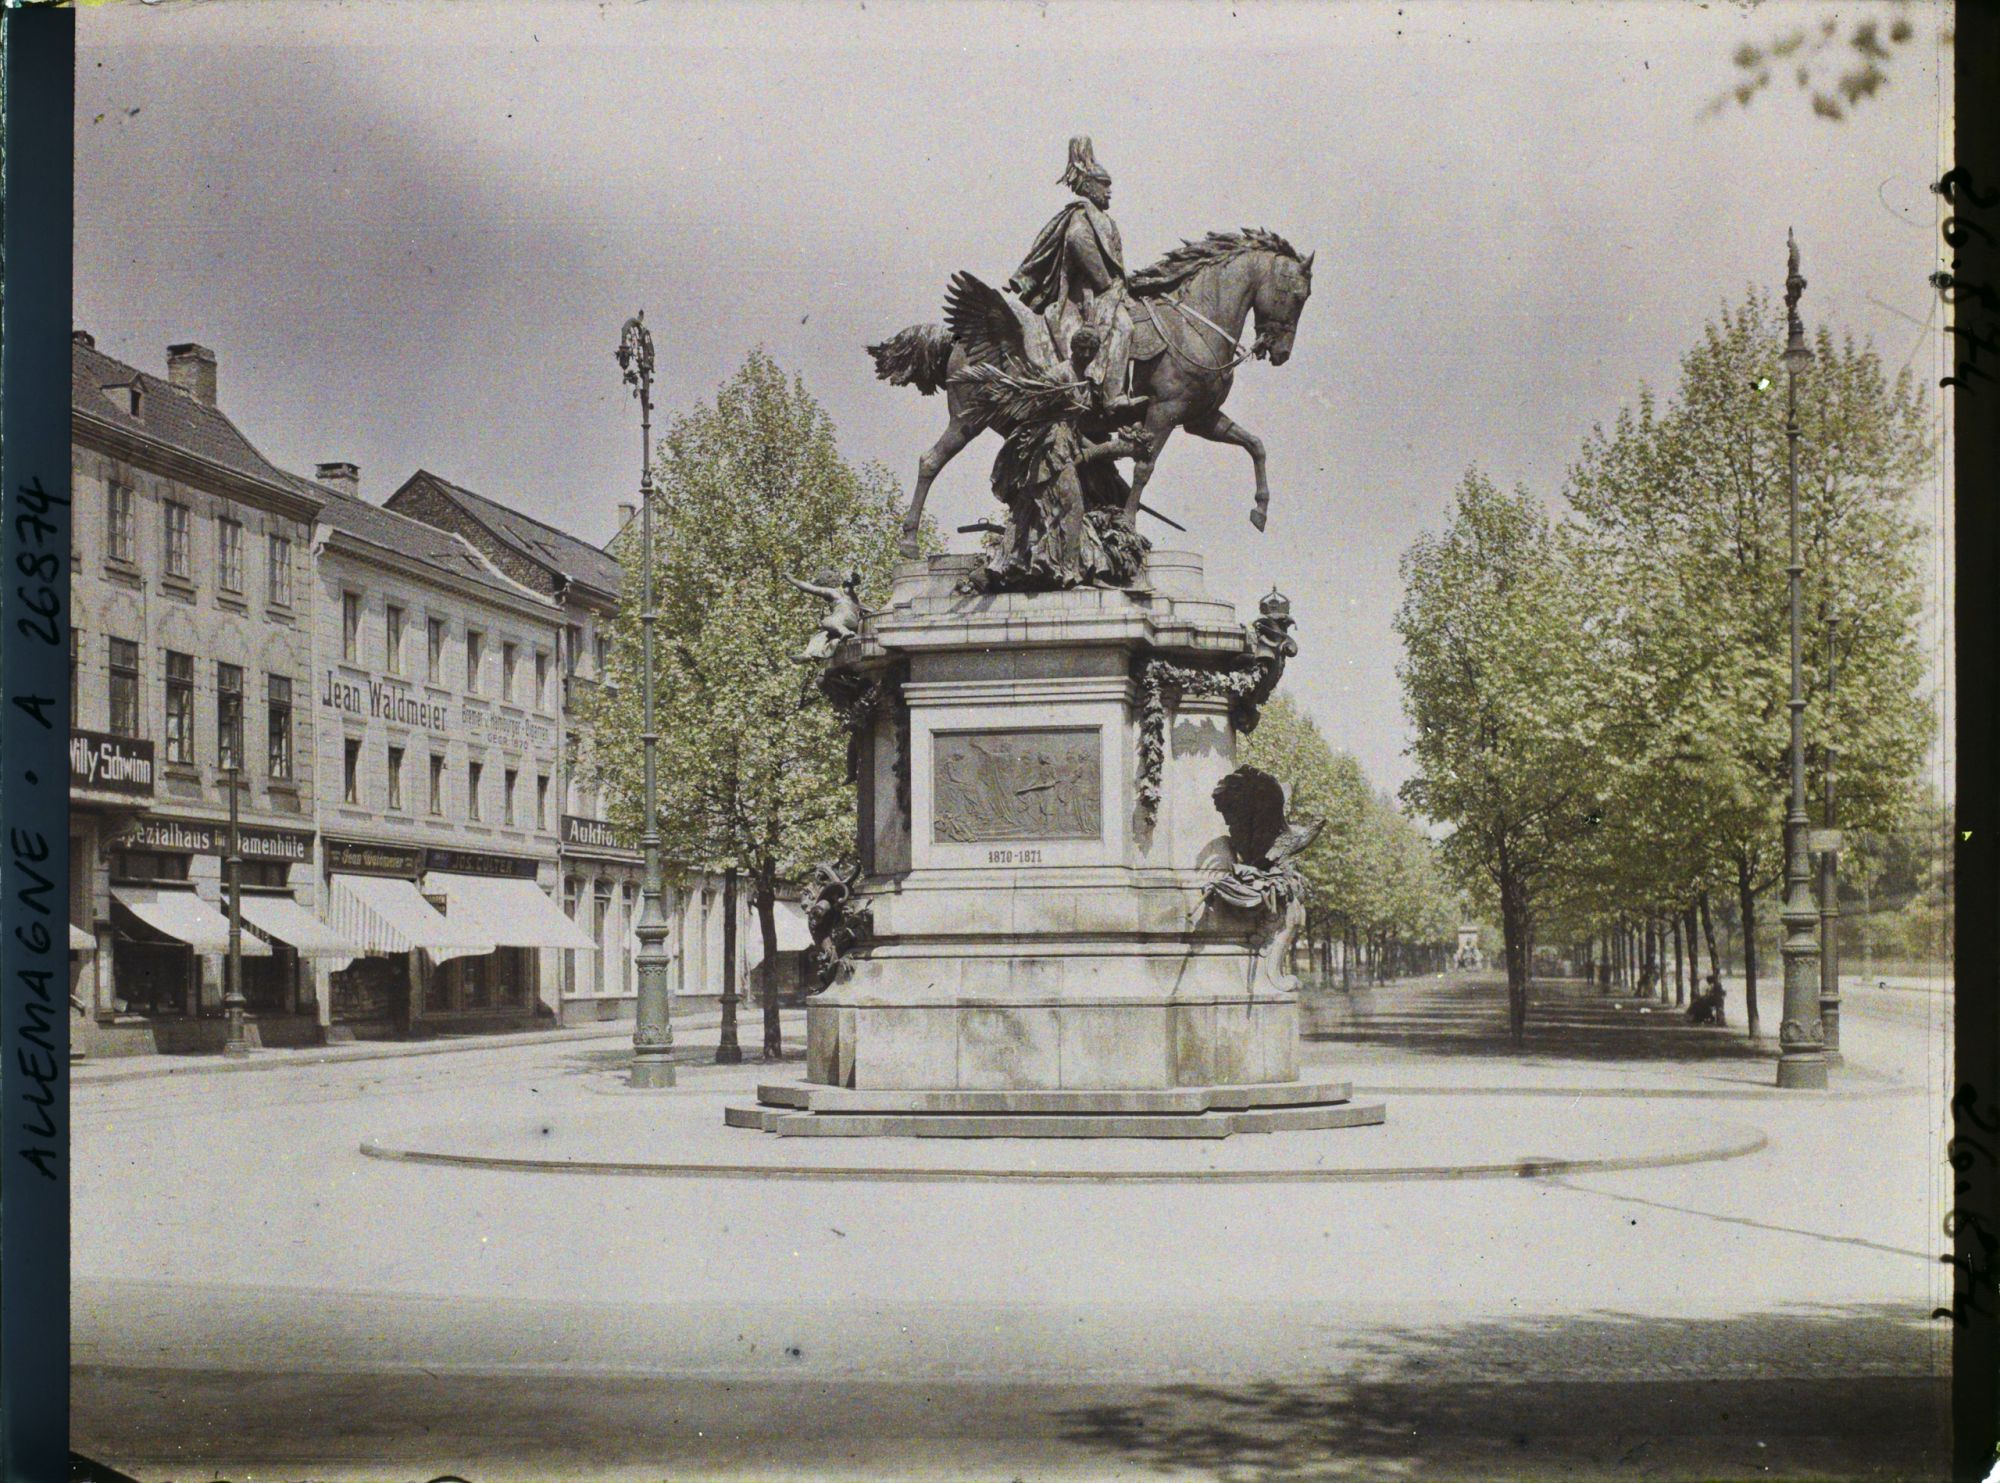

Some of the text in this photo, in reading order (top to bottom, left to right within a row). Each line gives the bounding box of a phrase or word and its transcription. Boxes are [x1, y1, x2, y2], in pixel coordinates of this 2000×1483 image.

[322, 670, 447, 731] Jean Waldmeier
[101, 743, 151, 783] Schwinn
